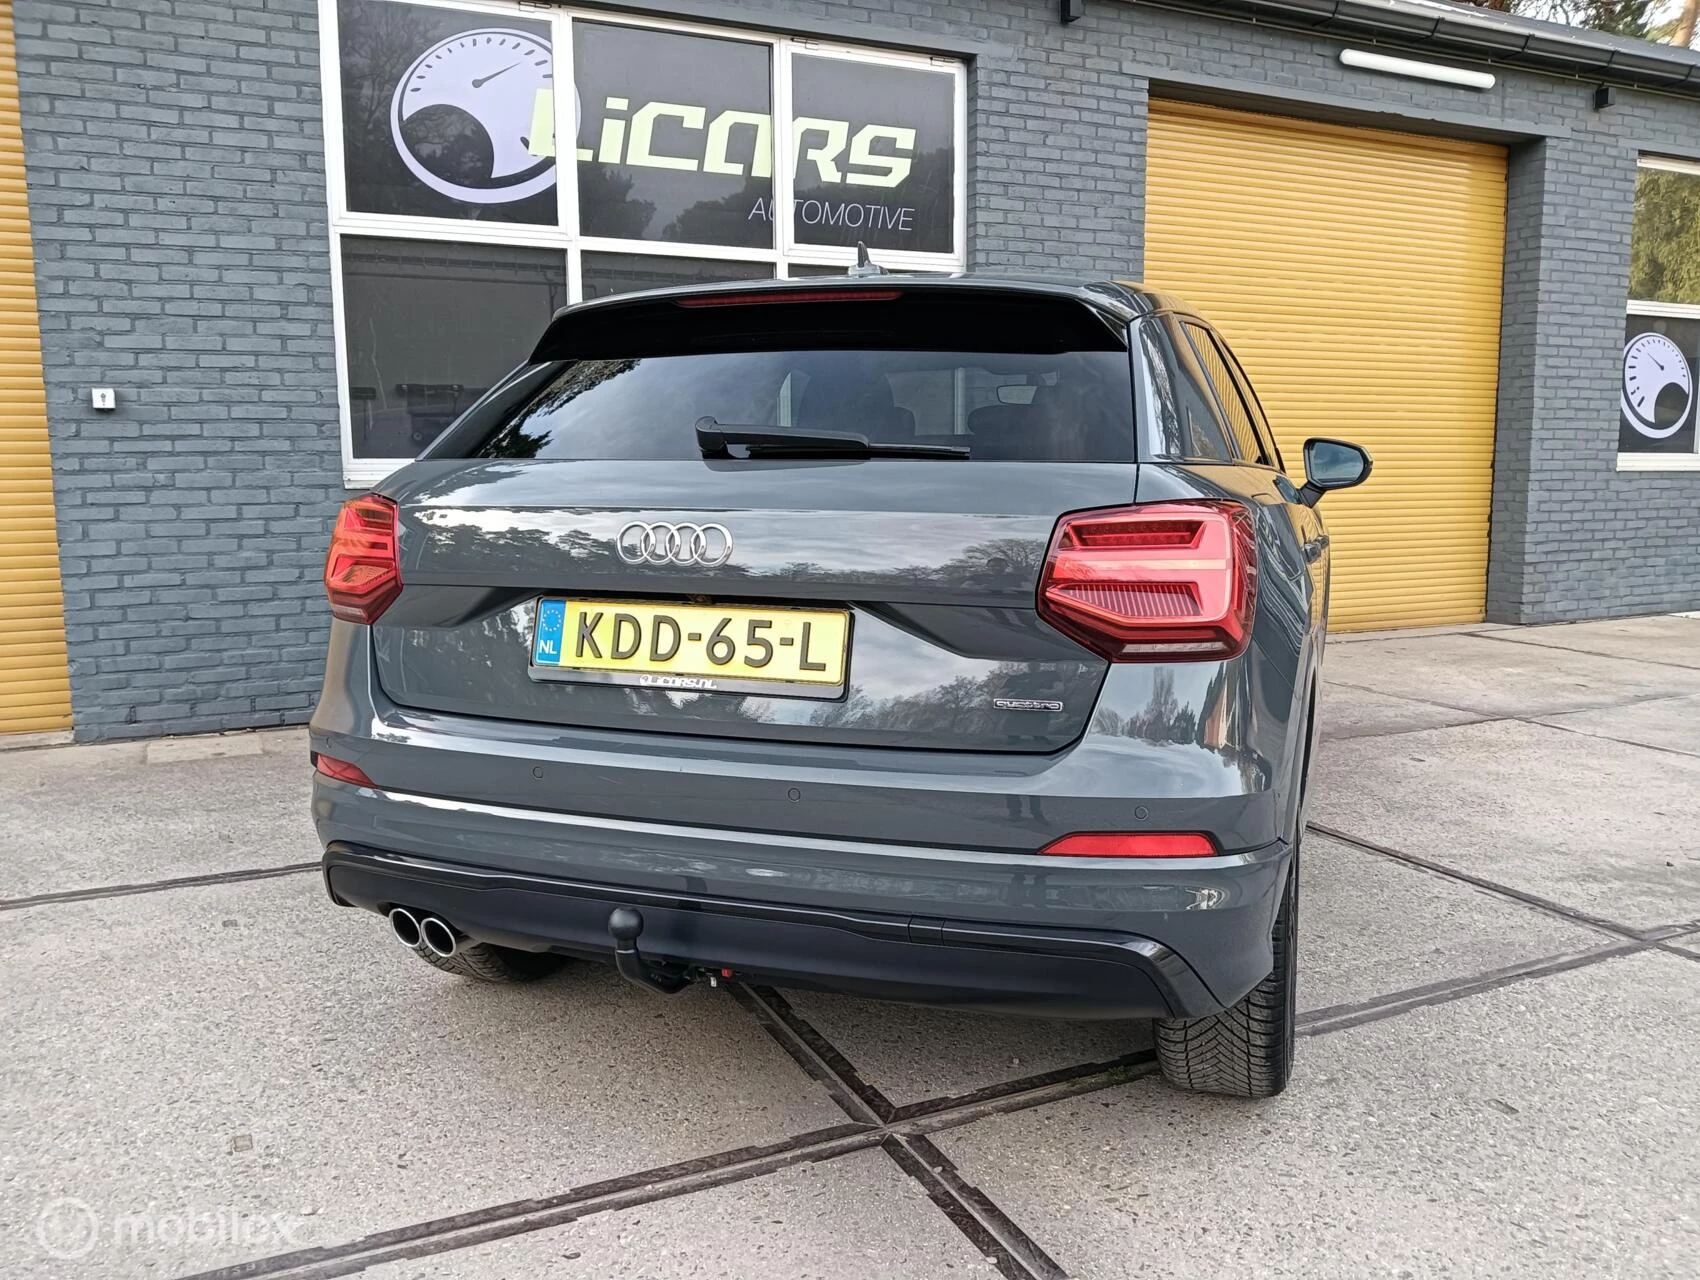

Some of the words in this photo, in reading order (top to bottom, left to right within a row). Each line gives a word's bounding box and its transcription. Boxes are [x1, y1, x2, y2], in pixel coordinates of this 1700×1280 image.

[539, 639, 558, 655] NL
[575, 611, 826, 672] KDD-65-L
[995, 700, 1061, 710] quattro
